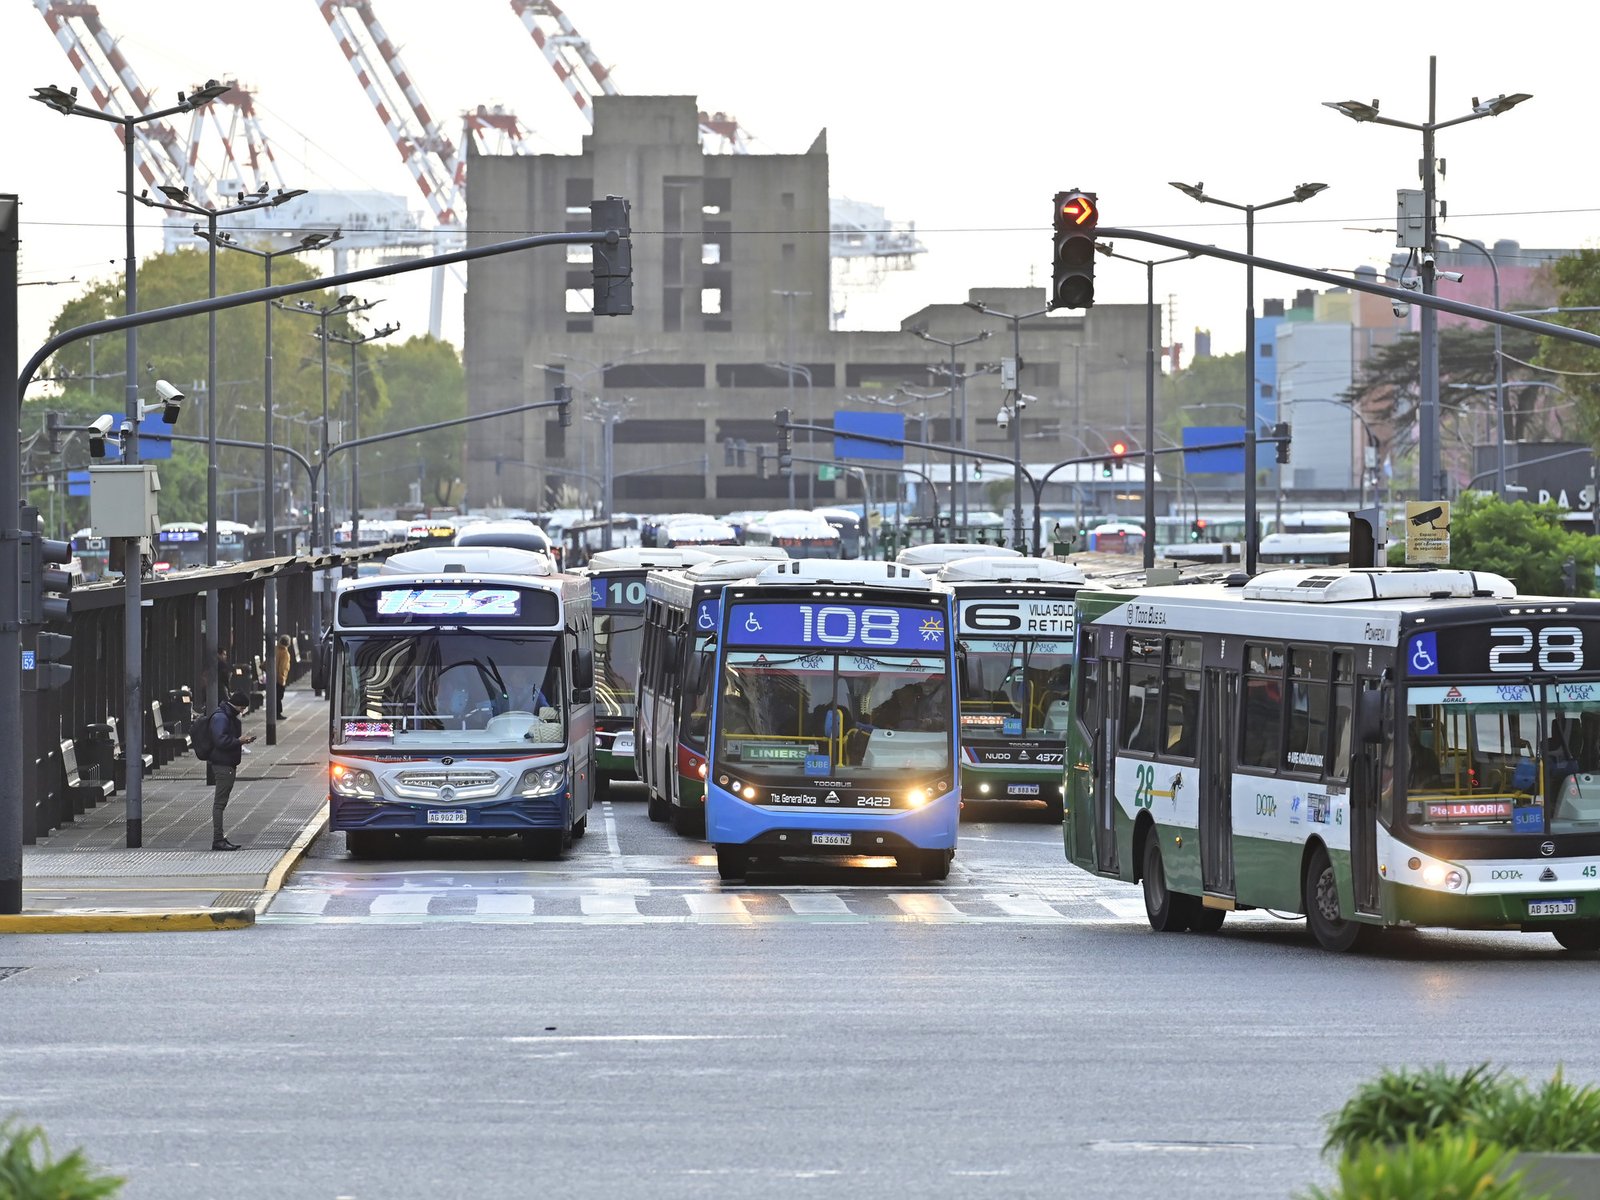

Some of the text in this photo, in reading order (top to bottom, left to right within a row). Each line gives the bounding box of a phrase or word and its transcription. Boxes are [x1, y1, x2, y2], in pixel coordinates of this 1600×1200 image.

[85, 539, 107, 550] 101
[377, 589, 520, 614] 152
[1029, 604, 1051, 616] VILLA
[964, 604, 1022, 630] 6
[800, 606, 900, 645] 108
[1489, 626, 1584, 672] 28
[1496, 685, 1528, 694] MEGA
[1562, 684, 1594, 694] MEGA
[1501, 692, 1524, 701] CAR
[1568, 692, 1590, 700] CAR
[750, 749, 808, 758] LINIERS
[1036, 753, 1064, 762] 4377
[806, 760, 829, 768] SUBE
[1135, 764, 1154, 810] 28
[782, 794, 802, 804] General
[803, 795, 817, 804] Roca
[857, 796, 891, 807] 2423
[1430, 804, 1505, 815] Pte. LA NORIA
[1515, 815, 1542, 824] SUBE
[1491, 866, 1597, 880] DOTA 45
[1530, 906, 1542, 914] AB
[1544, 905, 1560, 914] 151
